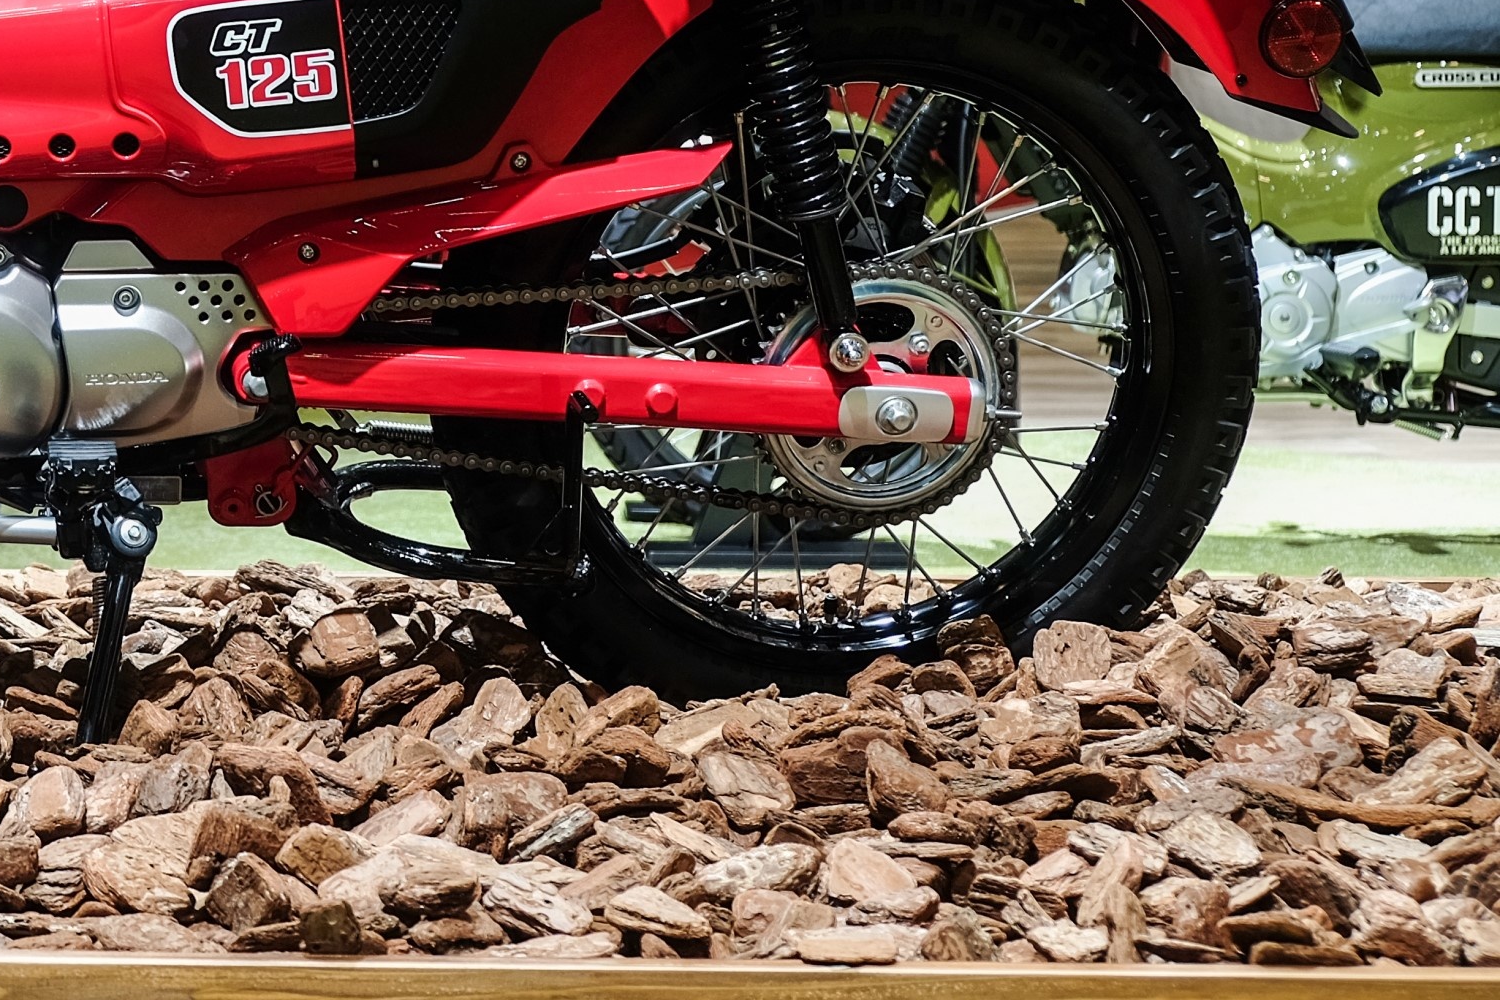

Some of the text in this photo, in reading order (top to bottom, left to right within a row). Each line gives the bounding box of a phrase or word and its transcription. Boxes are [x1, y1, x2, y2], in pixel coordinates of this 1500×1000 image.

[209, 18, 283, 56] CT
[216, 48, 338, 110] 125
[1421, 73, 1475, 83] CROSS
[84, 371, 170, 386] HONDA
